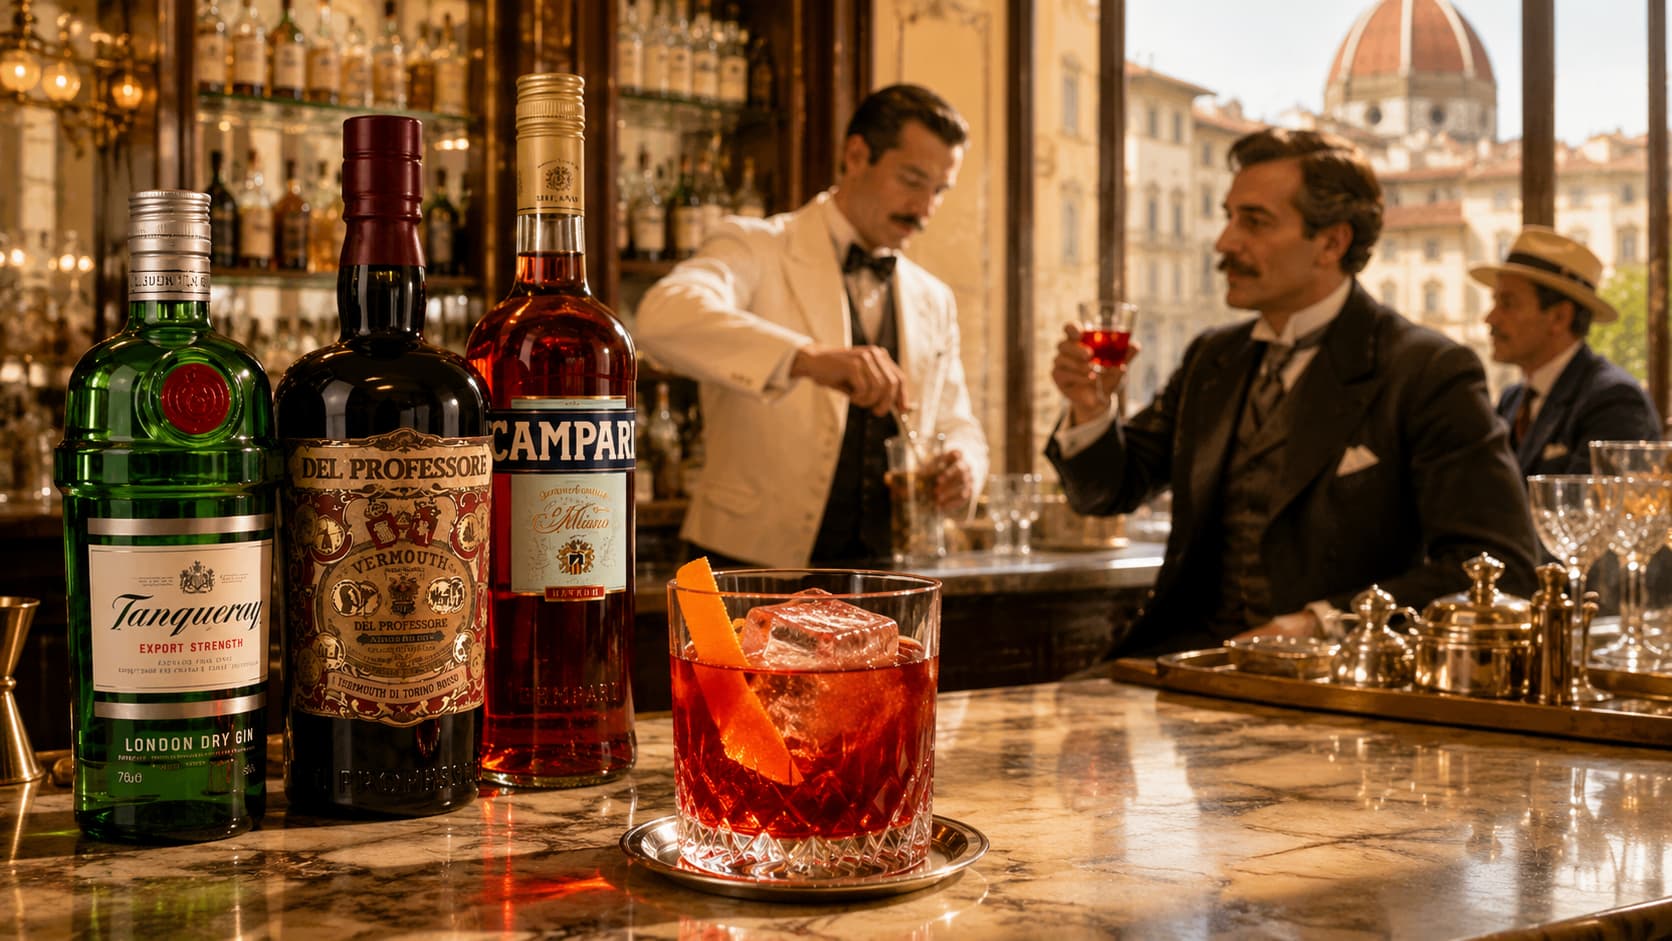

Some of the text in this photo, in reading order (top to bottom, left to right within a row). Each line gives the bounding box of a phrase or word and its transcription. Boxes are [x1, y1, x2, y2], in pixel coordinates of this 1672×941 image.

[491, 420, 635, 461] CAMPARI
[302, 454, 487, 480] DEL PROFESSORE
[352, 550, 449, 574] VERMOUTH
[111, 593, 263, 637] Tanqueray
[354, 618, 448, 631] DEL PROFESSORE
[139, 638, 243, 654] EXPORT STRENGTH
[389, 689, 399, 699] DI
[403, 685, 434, 698] TORINO
[125, 727, 254, 752] LONDON DRY GIN
